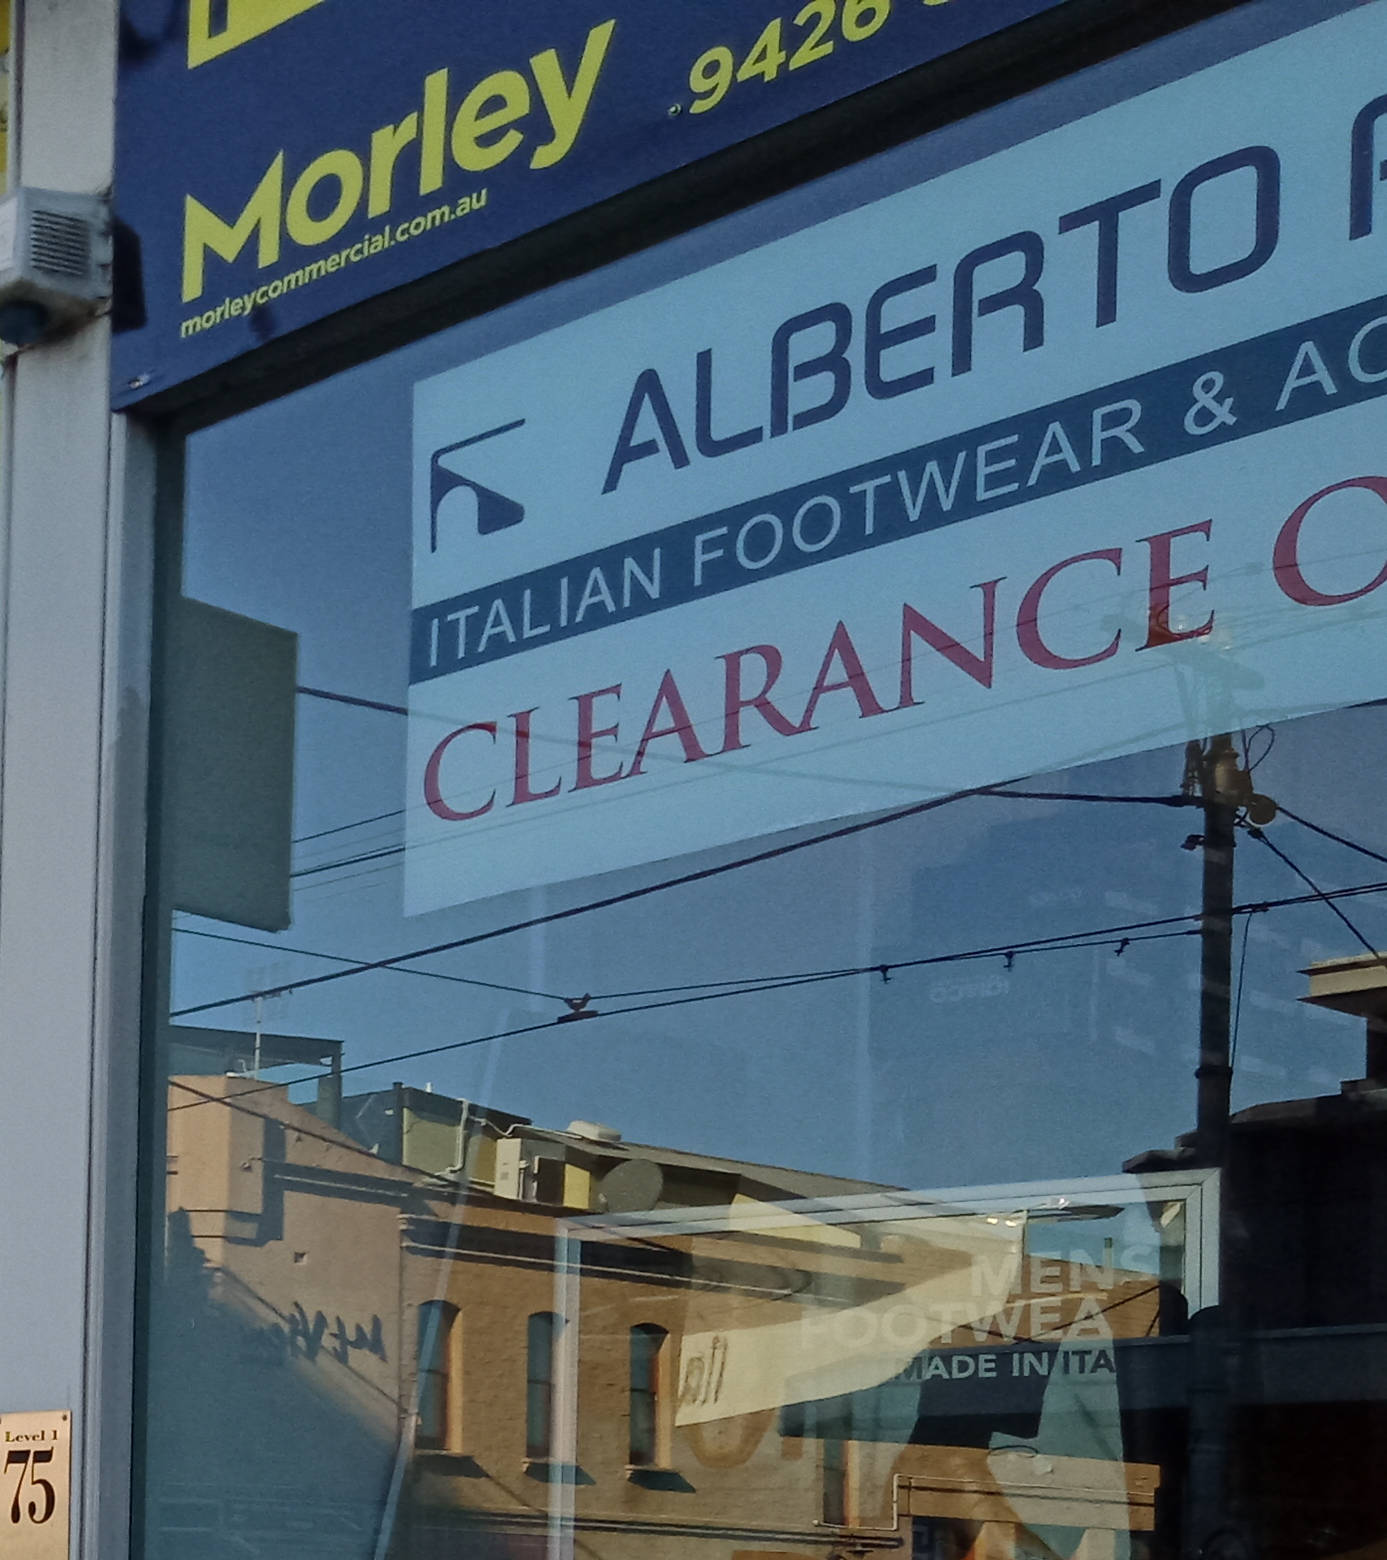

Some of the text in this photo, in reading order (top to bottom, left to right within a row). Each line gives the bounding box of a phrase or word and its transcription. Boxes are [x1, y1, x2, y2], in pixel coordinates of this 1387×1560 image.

[689, 0, 891, 114] 9426
[181, 19, 615, 304] Morley
[180, 188, 487, 338] morleycommercial.com.au
[602, 145, 1281, 494] ALBERTO
[427, 548, 662, 668] ITALIAN
[692, 398, 1144, 576] FOOTWEAR
[1186, 370, 1236, 437] &
[423, 518, 1214, 821] CLEARANCE
[5, 1430, 58, 1442] Level 1
[1013, 1351, 1050, 1378] IN
[3, 1446, 56, 1525] 75
